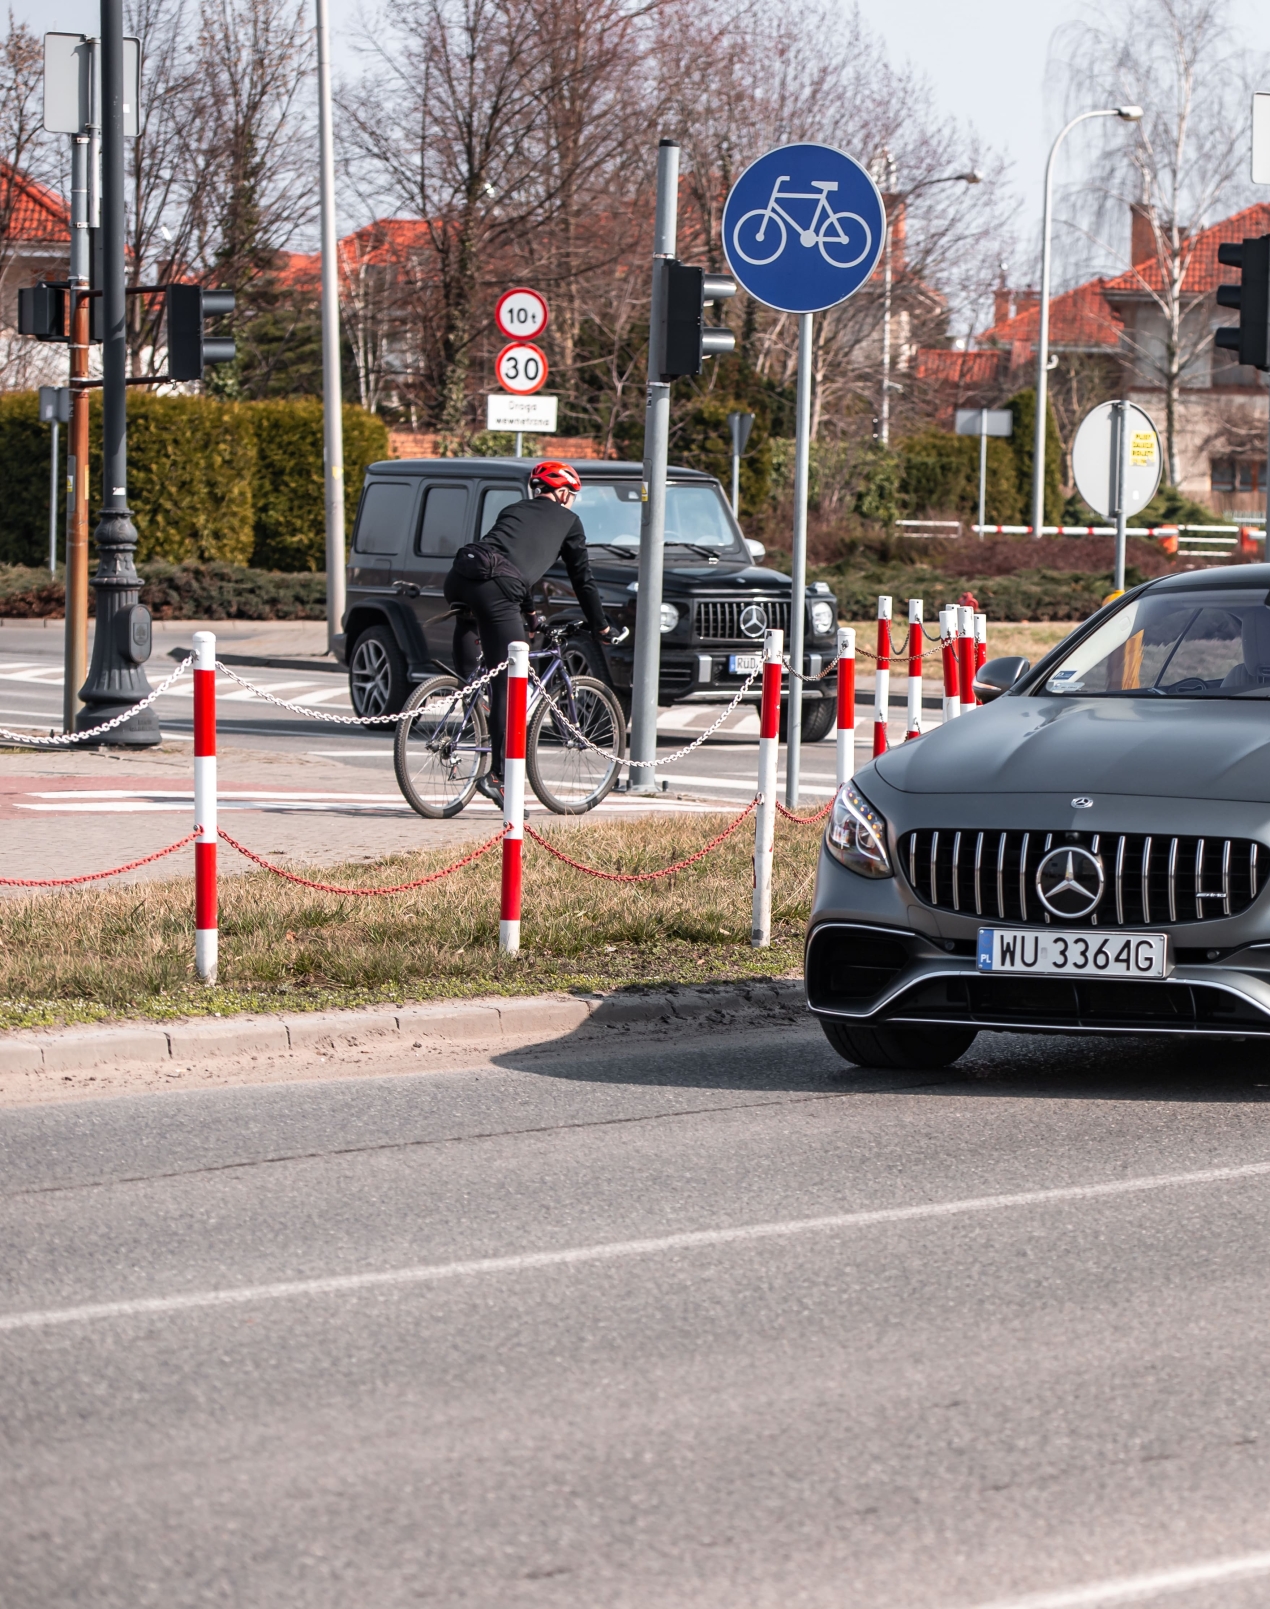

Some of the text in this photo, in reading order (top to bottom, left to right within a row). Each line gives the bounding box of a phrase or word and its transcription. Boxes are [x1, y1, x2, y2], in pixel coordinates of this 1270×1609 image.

[504, 356, 540, 381] 30
[979, 953, 992, 964] PL
[999, 934, 1156, 972] WU 3364G
